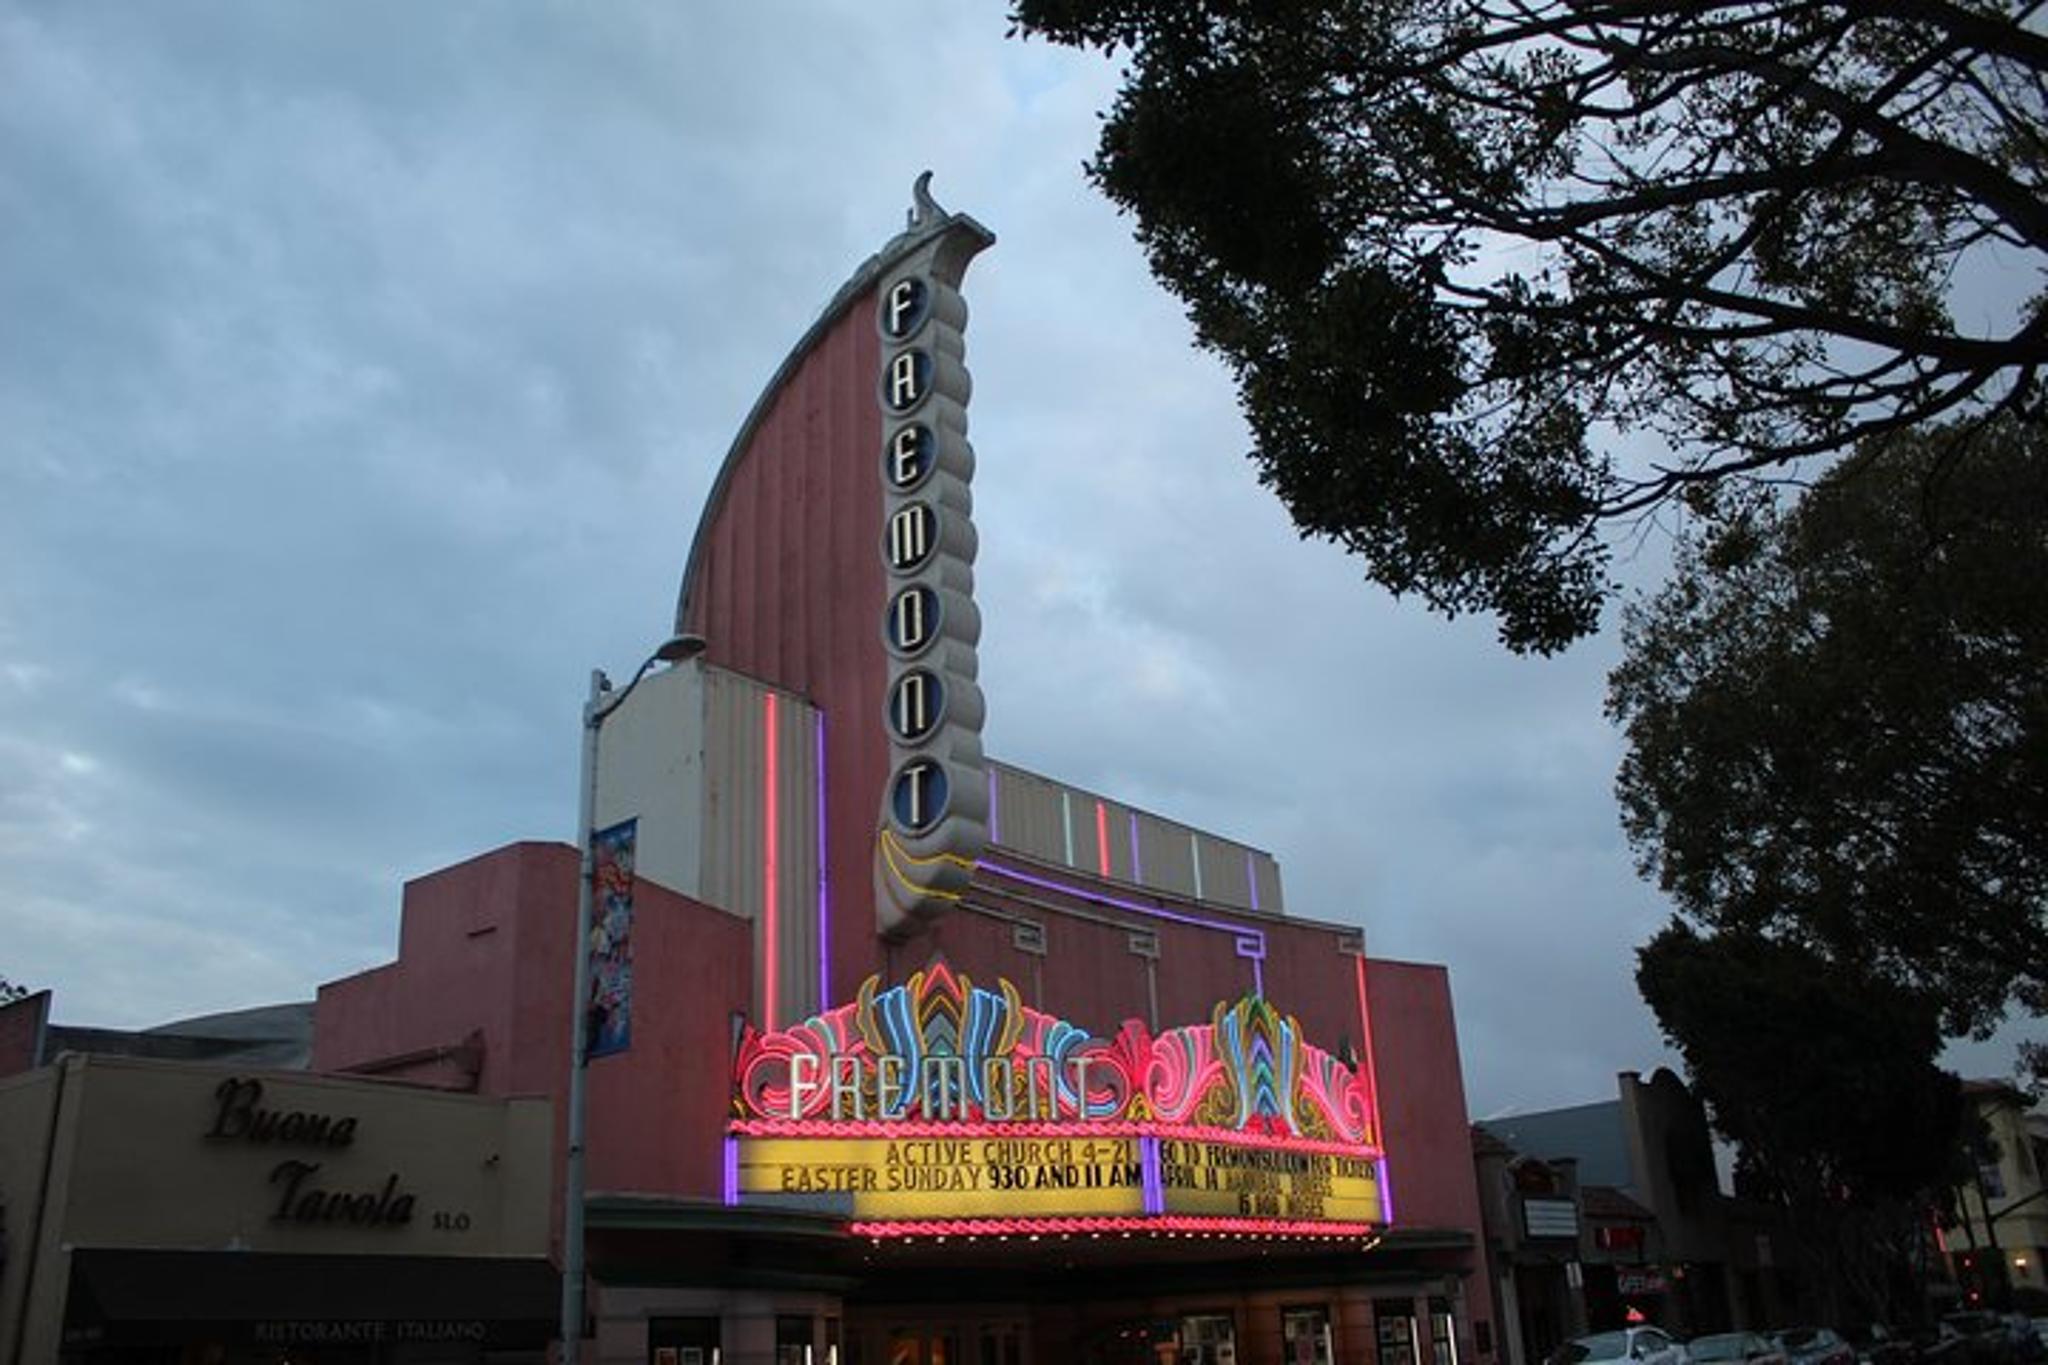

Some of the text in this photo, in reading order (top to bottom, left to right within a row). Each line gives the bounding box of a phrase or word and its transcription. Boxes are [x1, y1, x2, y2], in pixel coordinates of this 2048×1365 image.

[890, 280, 927, 824] FREMONT
[204, 1077, 358, 1147] Buona
[790, 1053, 1093, 1120] FREMONT
[781, 1168, 877, 1193] EASTER
[886, 1166, 980, 1191] SUNDAY
[989, 1164, 1029, 1189] 930
[1035, 1163, 1078, 1187] AND
[1107, 1161, 1142, 1187] AM
[885, 1139, 1133, 1165] ACTIVE CHURCH 4-21
[268, 1160, 416, 1227] Tavola
[255, 1321, 486, 1342] RISTORANTE ITALIANO
